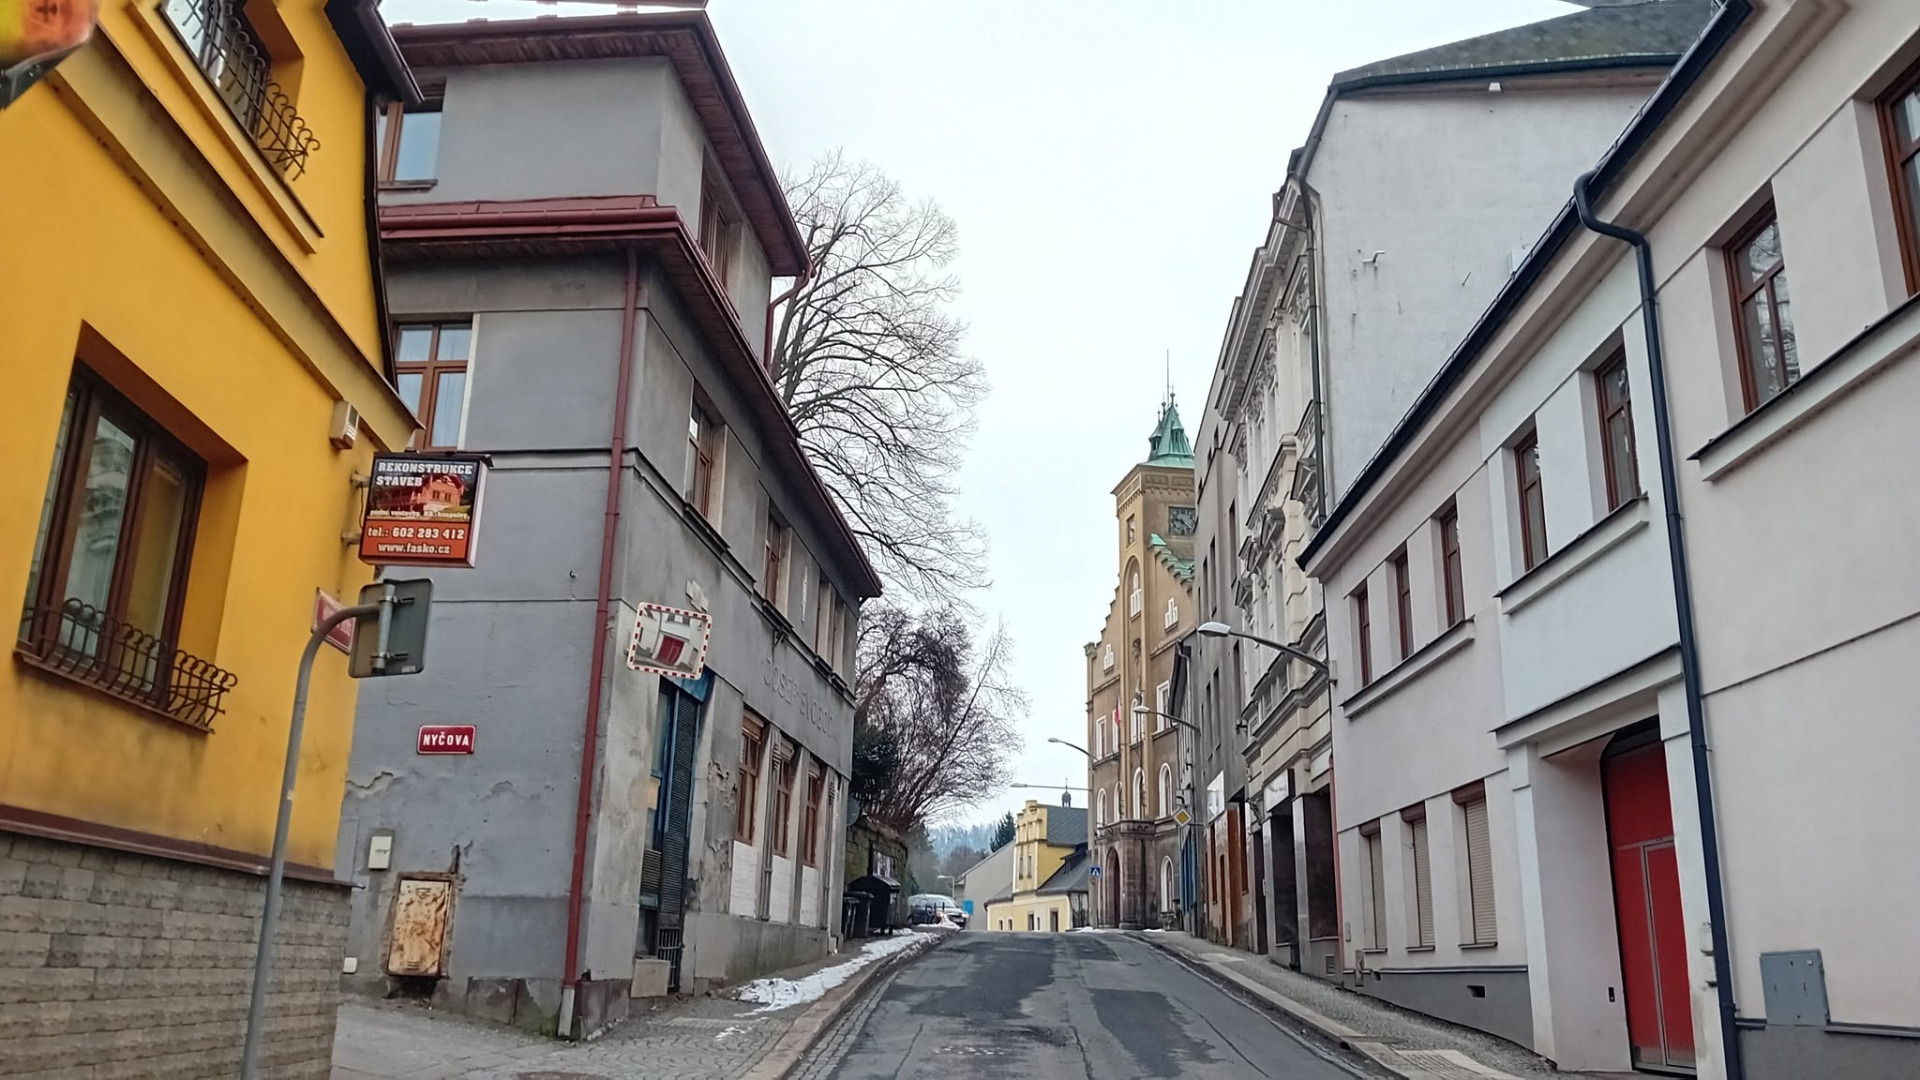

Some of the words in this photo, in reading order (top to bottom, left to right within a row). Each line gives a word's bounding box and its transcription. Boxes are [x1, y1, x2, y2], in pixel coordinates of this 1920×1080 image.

[378, 462, 473, 475] REKONSTRUKCE
[376, 475, 423, 487] STAVEB
[368, 526, 389, 537] tel.:
[392, 527, 414, 538] 602
[417, 528, 439, 539] 283
[442, 528, 465, 540] 412
[423, 731, 469, 746] NYČOVA
